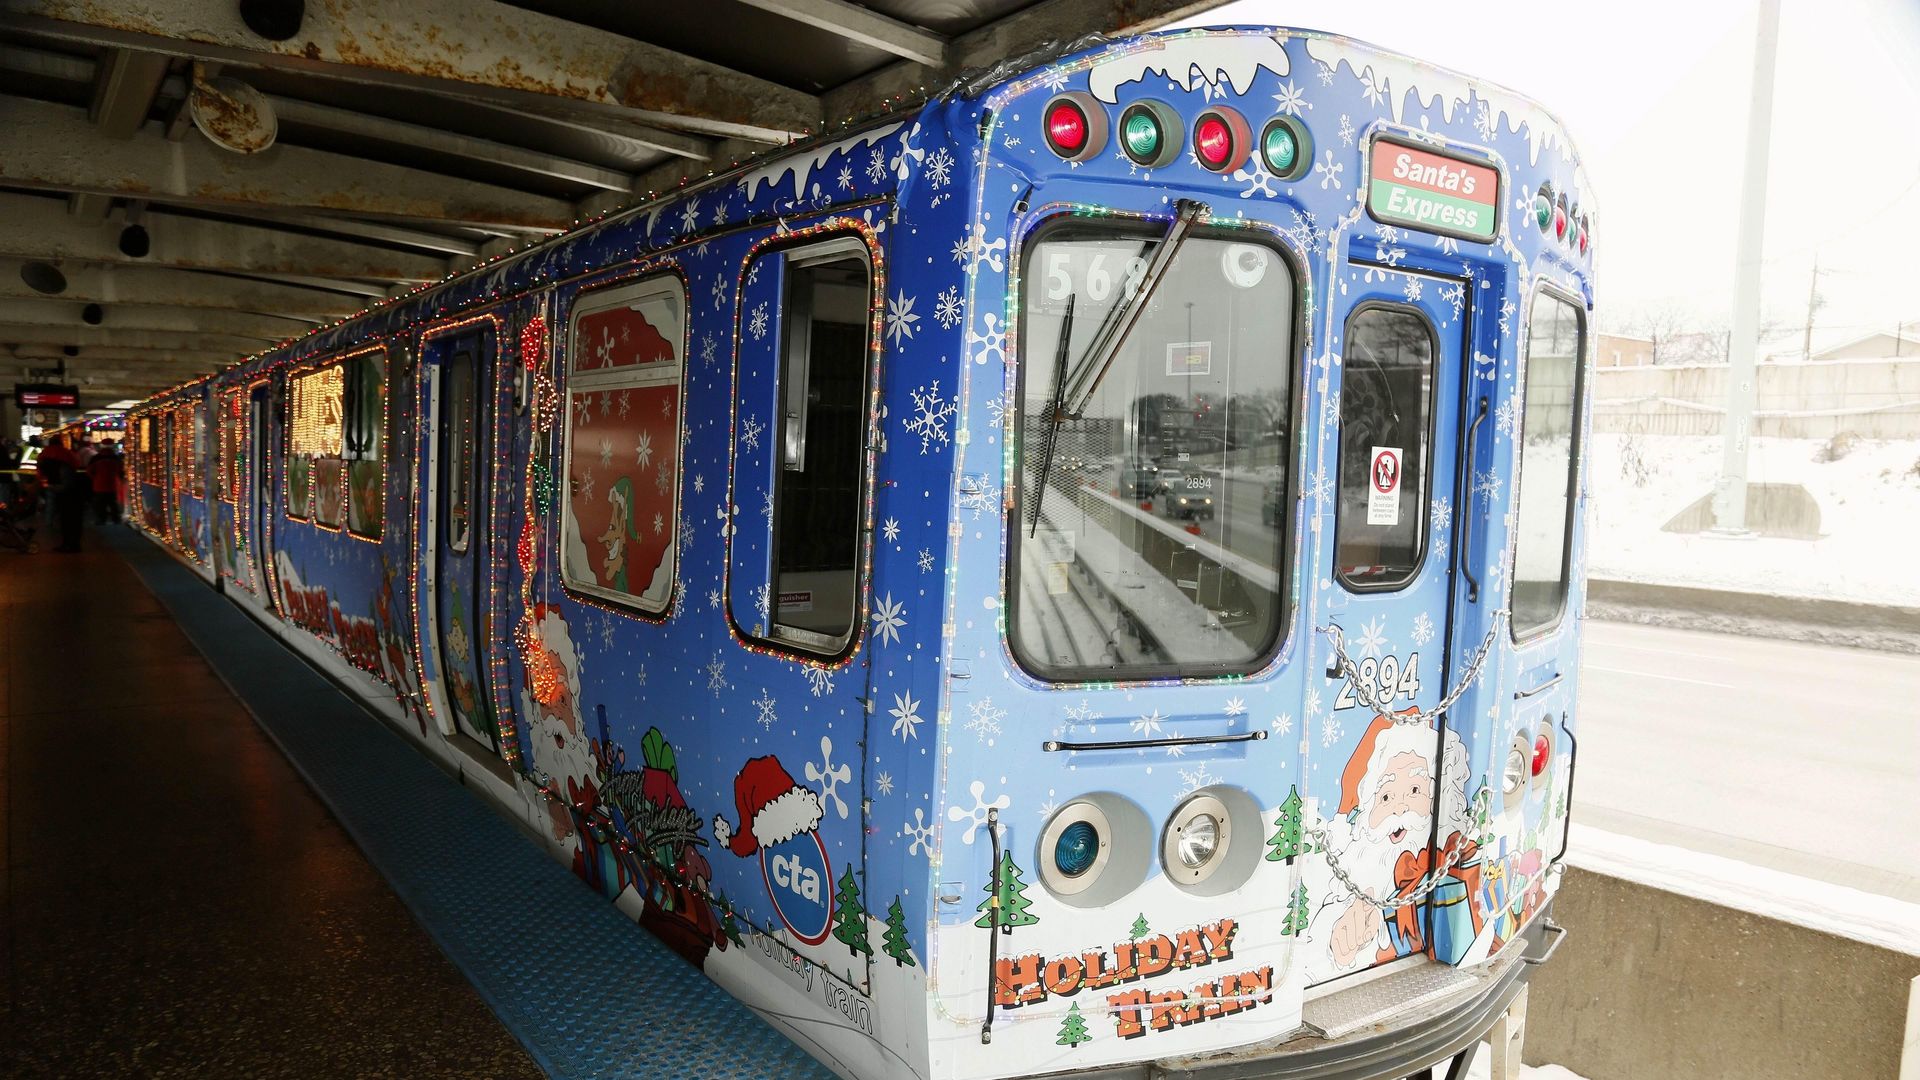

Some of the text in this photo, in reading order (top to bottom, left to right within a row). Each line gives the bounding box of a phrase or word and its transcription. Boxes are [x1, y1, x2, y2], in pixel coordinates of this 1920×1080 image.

[1393, 153, 1475, 194] Santa's
[1387, 187, 1478, 229] Express
[1186, 477, 1212, 489] 2894
[1333, 652, 1420, 711] 2894
[772, 854, 820, 904] cta
[994, 917, 1239, 1009] HOLIDAY
[820, 969, 873, 1035] train
[1106, 962, 1273, 1040] TRAIN
